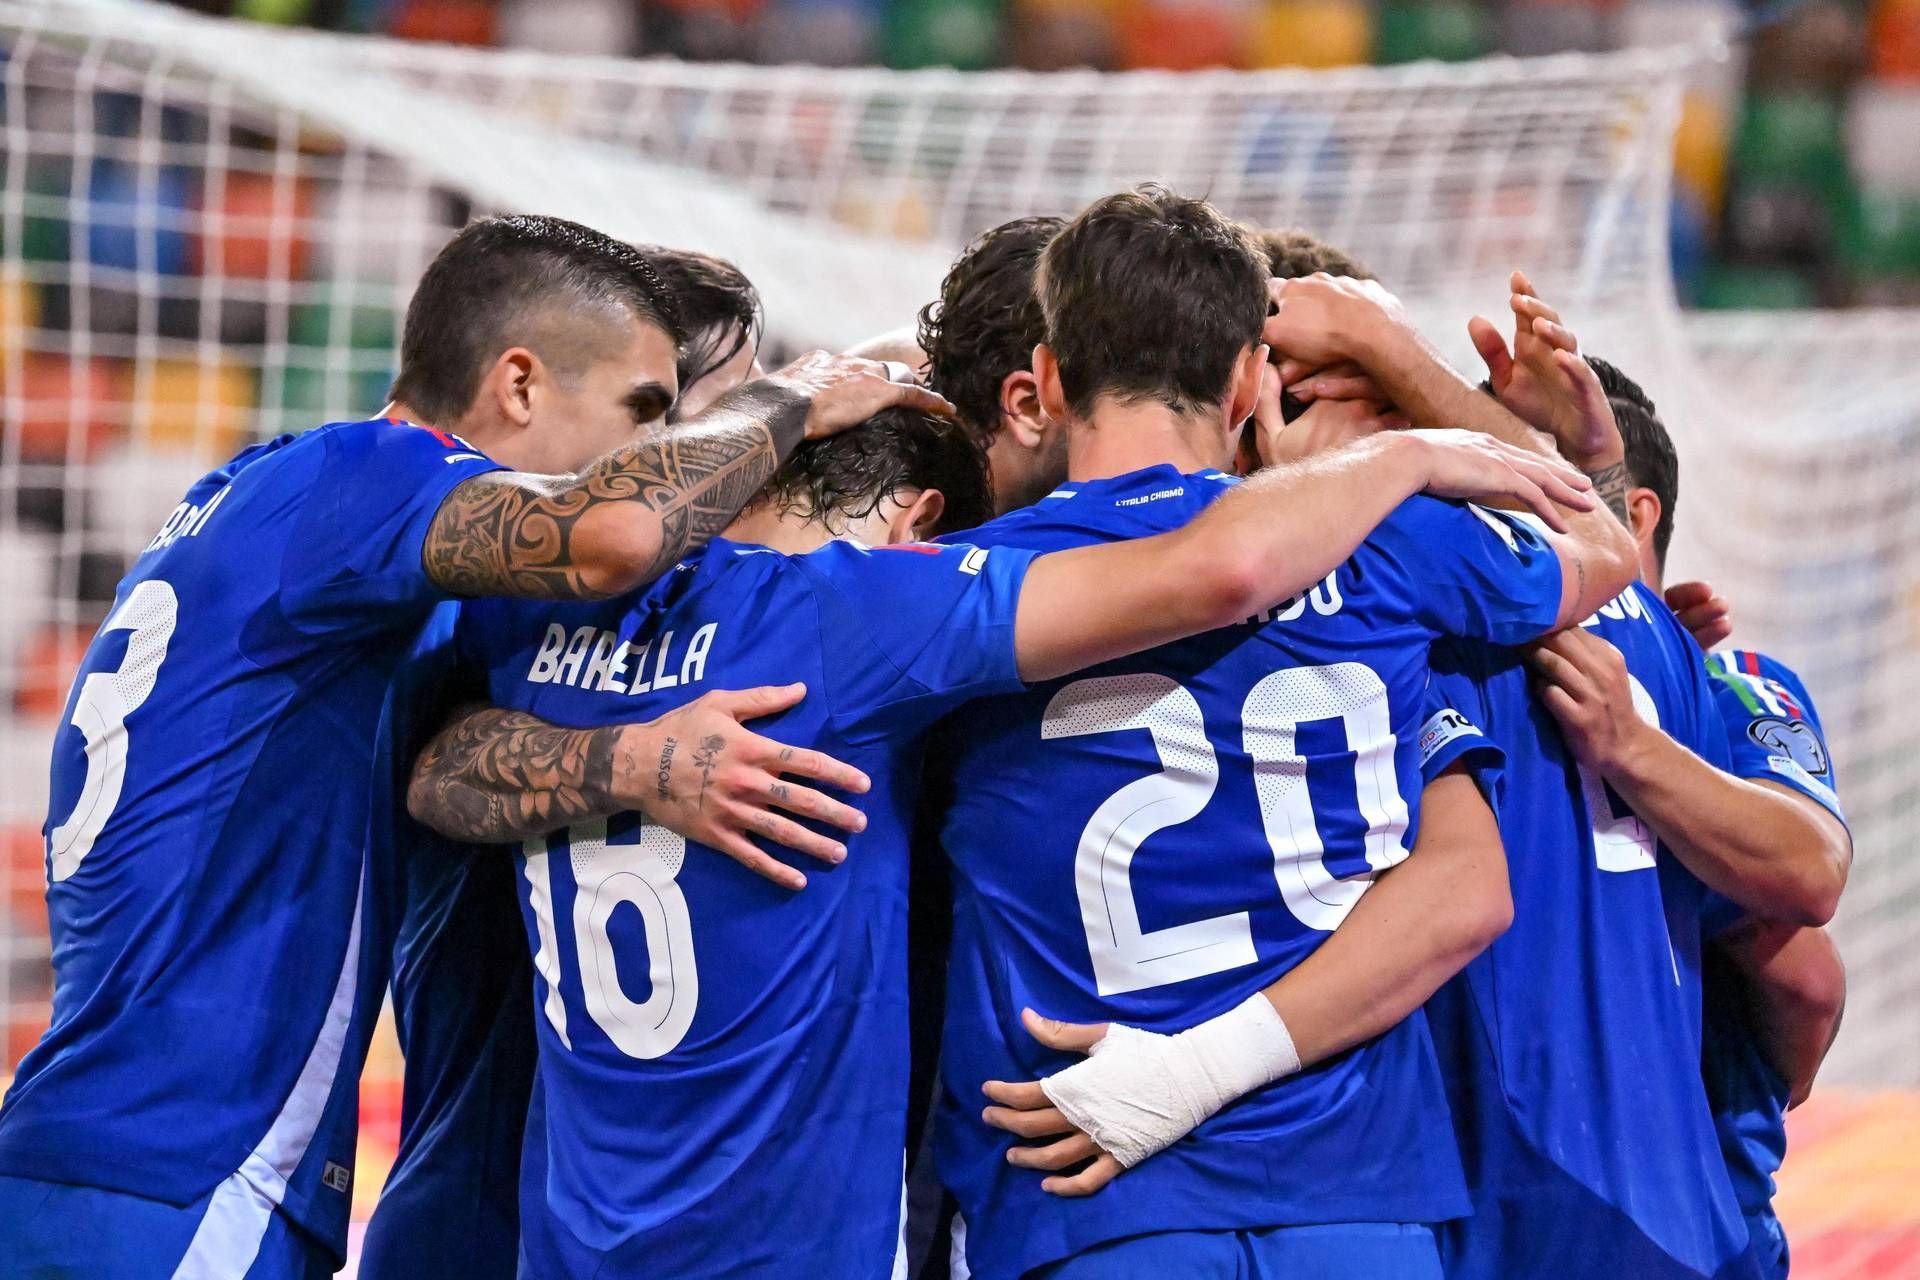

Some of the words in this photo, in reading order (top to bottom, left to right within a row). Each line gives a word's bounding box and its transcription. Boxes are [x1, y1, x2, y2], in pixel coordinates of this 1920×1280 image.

[527, 622, 718, 696] BARELLA
[521, 812, 699, 1060] 18
[1041, 661, 1409, 996] 20
